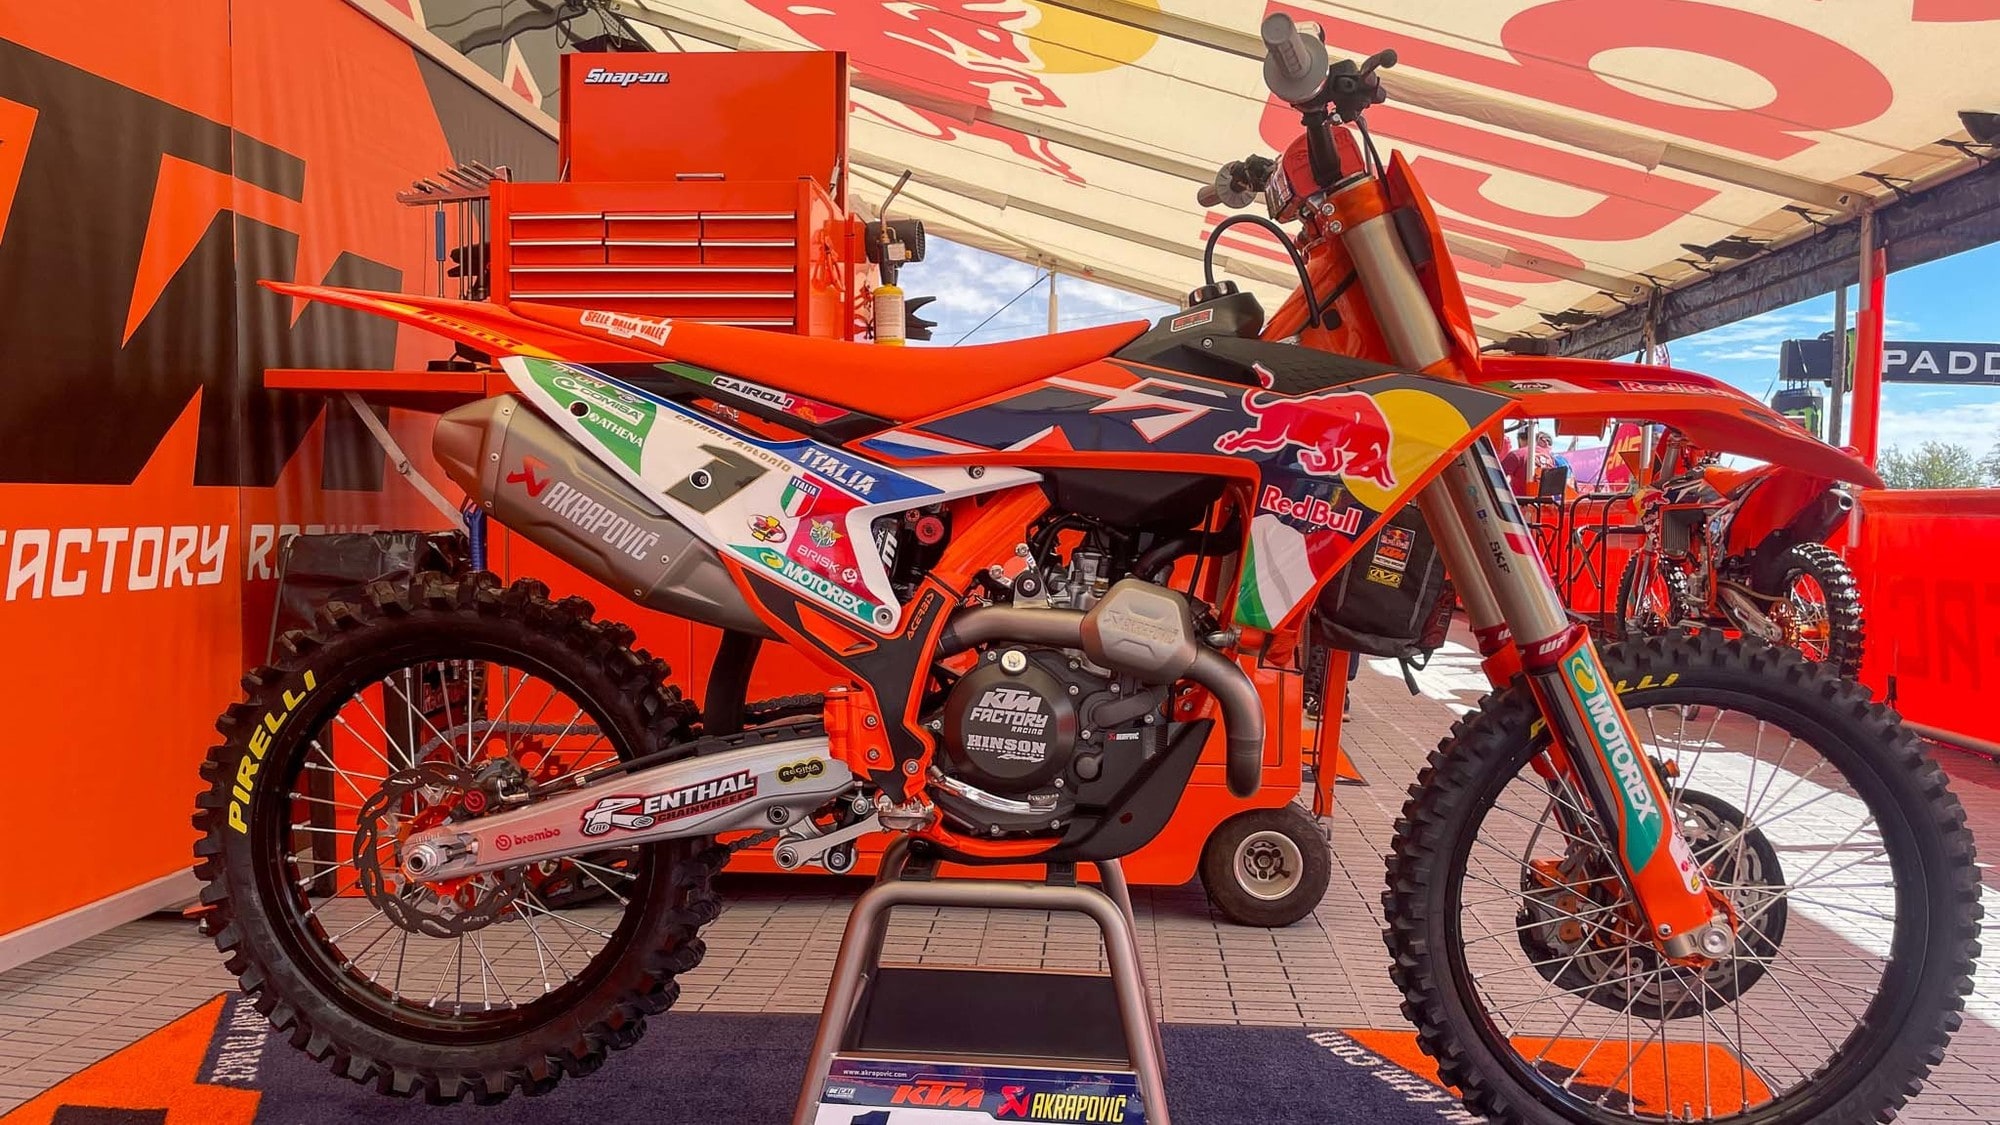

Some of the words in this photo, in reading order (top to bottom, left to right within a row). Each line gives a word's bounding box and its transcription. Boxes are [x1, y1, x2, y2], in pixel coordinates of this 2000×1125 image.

[585, 68, 669, 87] Snap-on
[1838, 195, 1848, 205] 4
[585, 311, 611, 325] SELLE
[640, 324, 666, 340] VALLE
[580, 388, 641, 421] COMISA
[712, 376, 794, 408] CAIROLI
[599, 419, 643, 448] ATHENA
[675, 413, 731, 442] CAIROLI
[799, 447, 879, 496] ITALIA
[792, 477, 816, 496] ITALIA
[1260, 485, 1314, 522] Red
[1308, 498, 1362, 536] Bull
[0, 525, 230, 601] ACTORY
[798, 545, 840, 573] BRISK
[1489, 541, 1510, 574] SKF
[783, 562, 861, 614] MOTOREX
[978, 688, 1042, 712] KTM
[970, 708, 1049, 728] FACTORY
[1011, 726, 1044, 736] RACING
[228, 669, 317, 834] PIRELLI
[967, 734, 1046, 754] HINSON
[1586, 692, 1657, 824] MOTOREX
[657, 790, 755, 823] CHAINWHEELS
[514, 827, 561, 845] brembo
[890, 1080, 985, 1108] KTM
